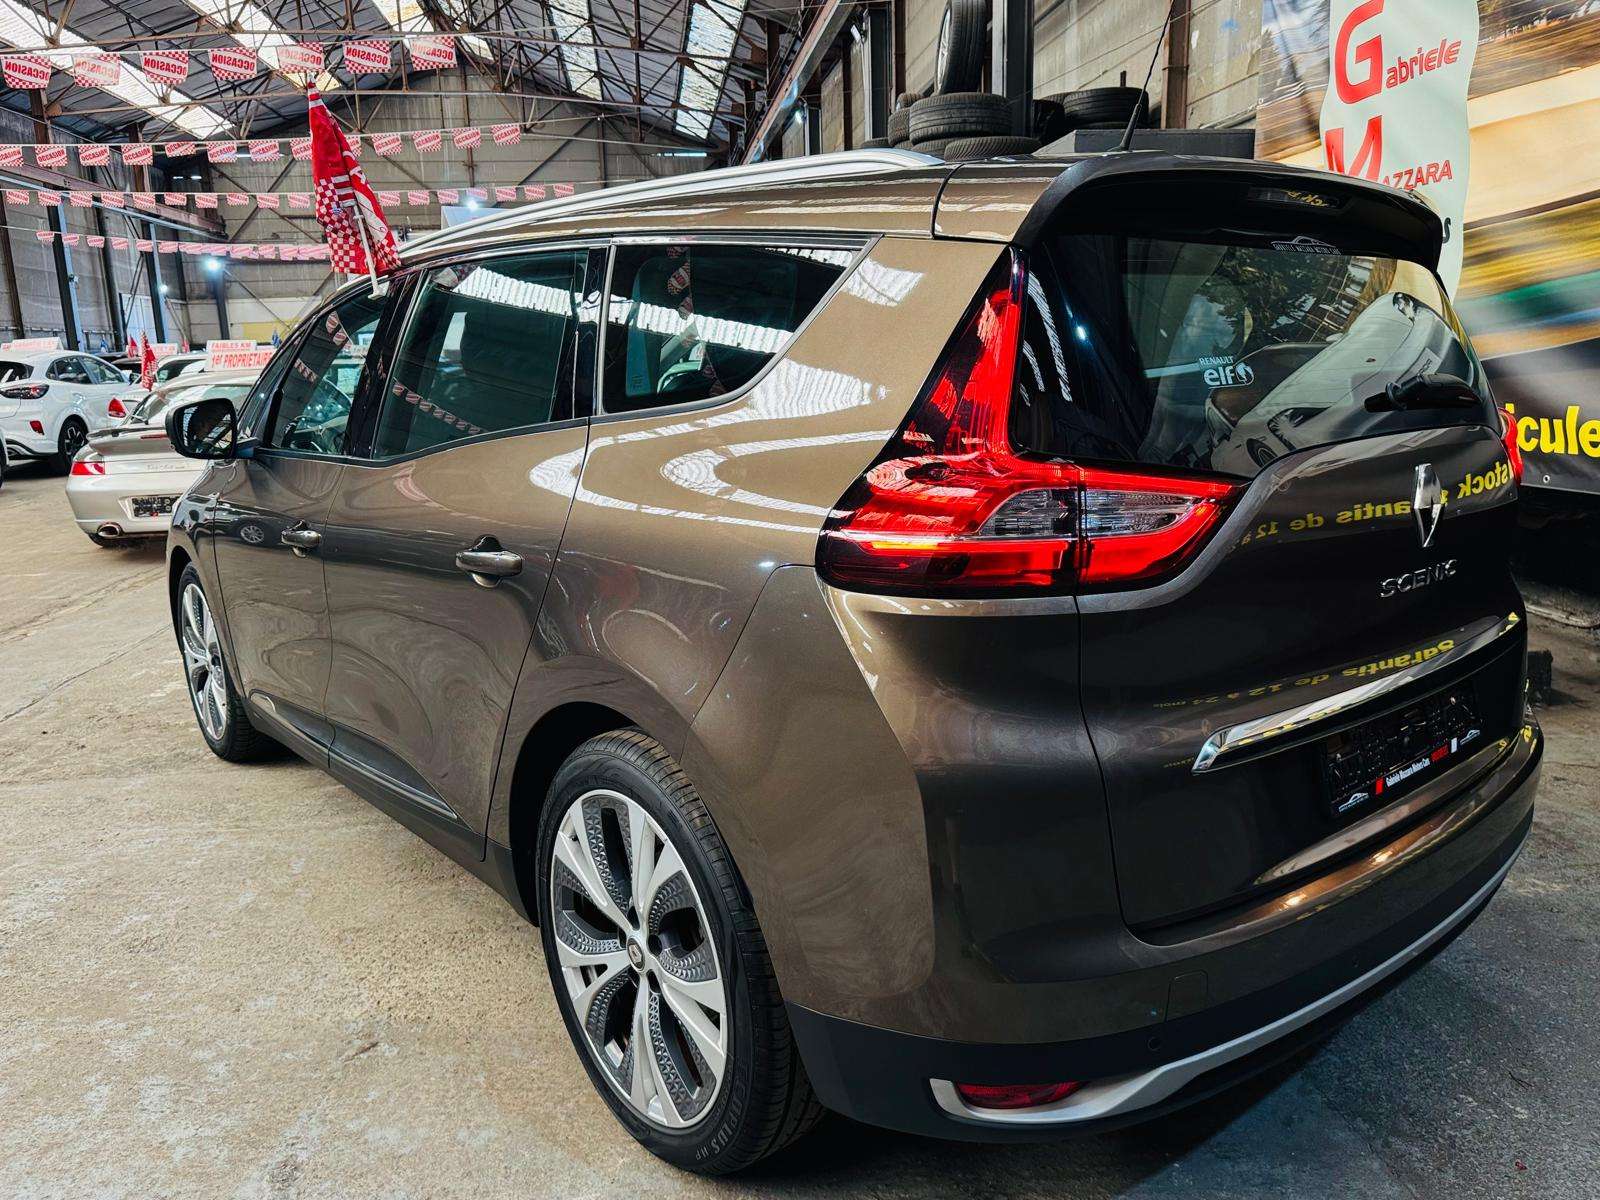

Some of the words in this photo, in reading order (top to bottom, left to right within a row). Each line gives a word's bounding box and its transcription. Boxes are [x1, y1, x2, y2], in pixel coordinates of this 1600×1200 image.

[1335, 0, 1462, 104] Gabriele
[1199, 355, 1234, 366] RENAULT
[1204, 365, 1235, 386] elf
[1505, 402, 1600, 458] cule
[1380, 559, 1457, 598] SCENIC
